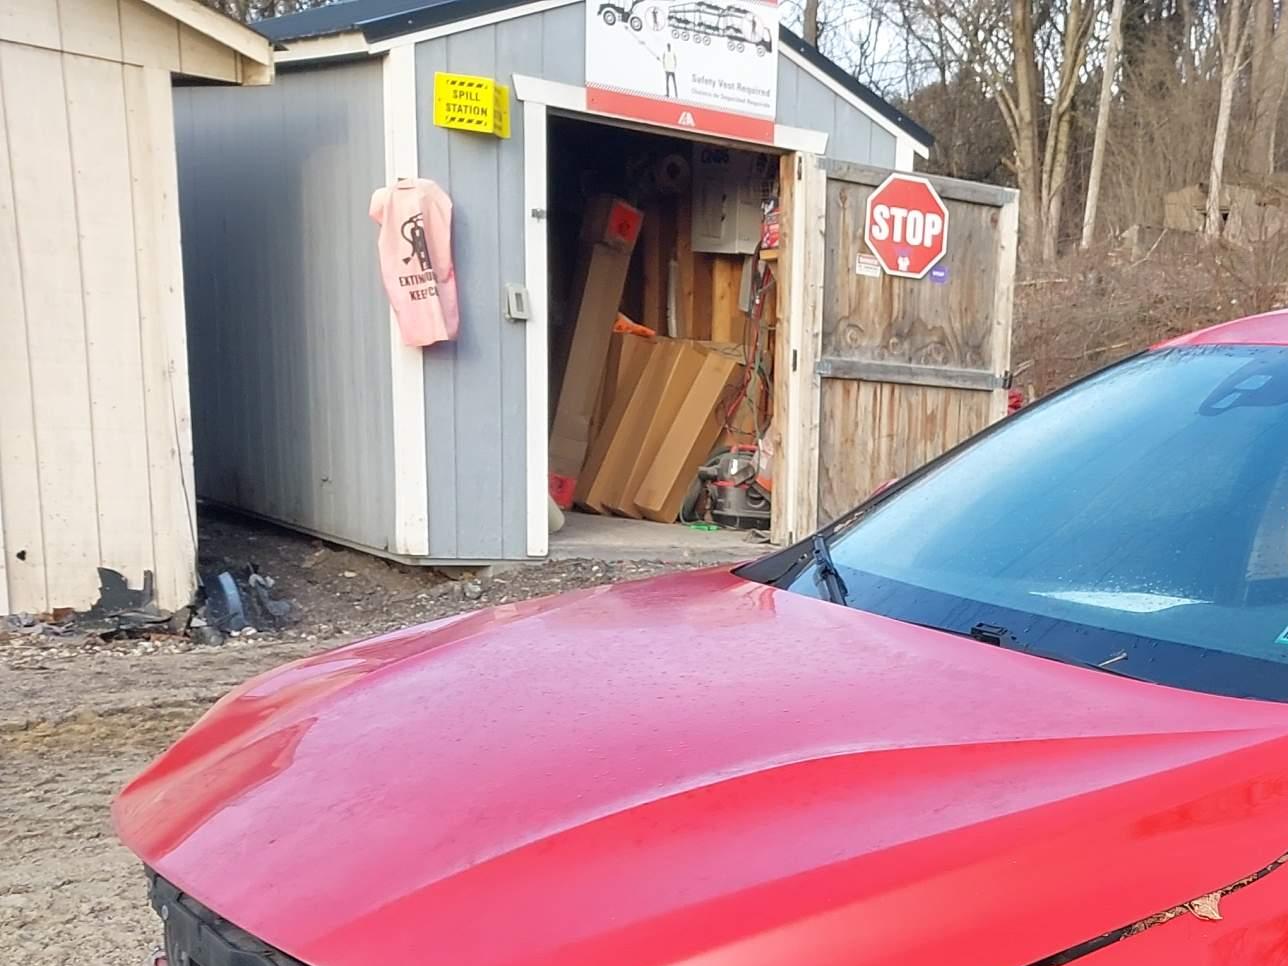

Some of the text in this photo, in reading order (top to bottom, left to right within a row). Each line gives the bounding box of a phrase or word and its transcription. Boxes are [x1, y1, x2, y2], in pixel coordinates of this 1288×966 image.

[453, 89, 480, 102] SPILL
[718, 79, 735, 91] Vest
[737, 82, 771, 98] Required
[446, 103, 488, 117] STATION
[871, 204, 942, 248] STOP
